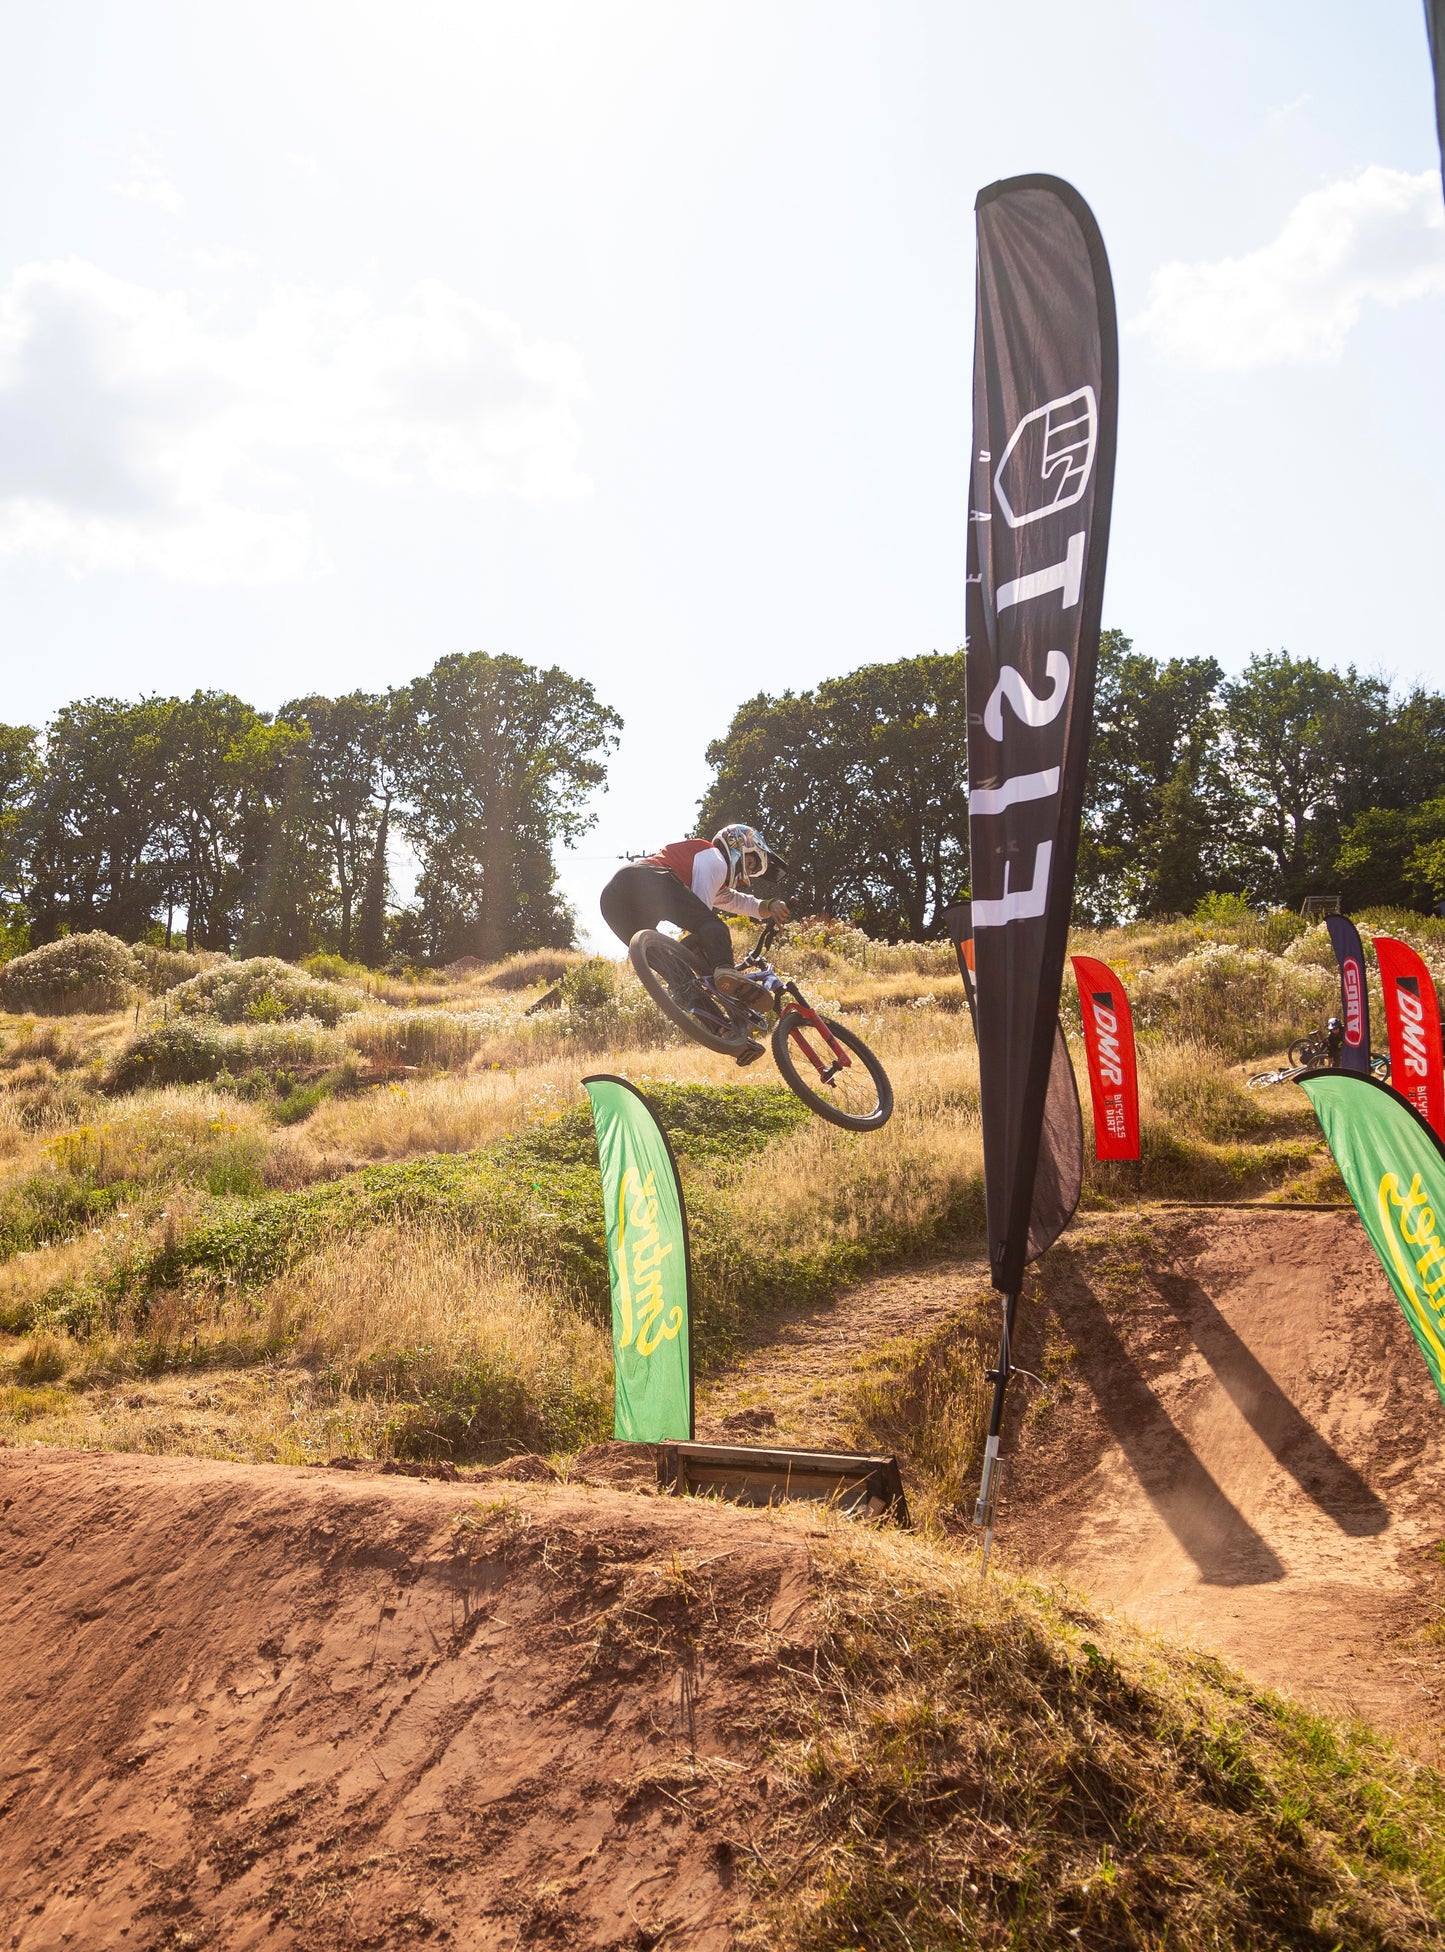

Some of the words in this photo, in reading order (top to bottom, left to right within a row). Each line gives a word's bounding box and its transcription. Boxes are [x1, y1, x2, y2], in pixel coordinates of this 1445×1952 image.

[1093, 1003, 1123, 1086] DMR
[1397, 989, 1428, 1077] DMR
[1106, 1109, 1117, 1133] DIRT
[1114, 1094, 1126, 1139] BICYCLES
